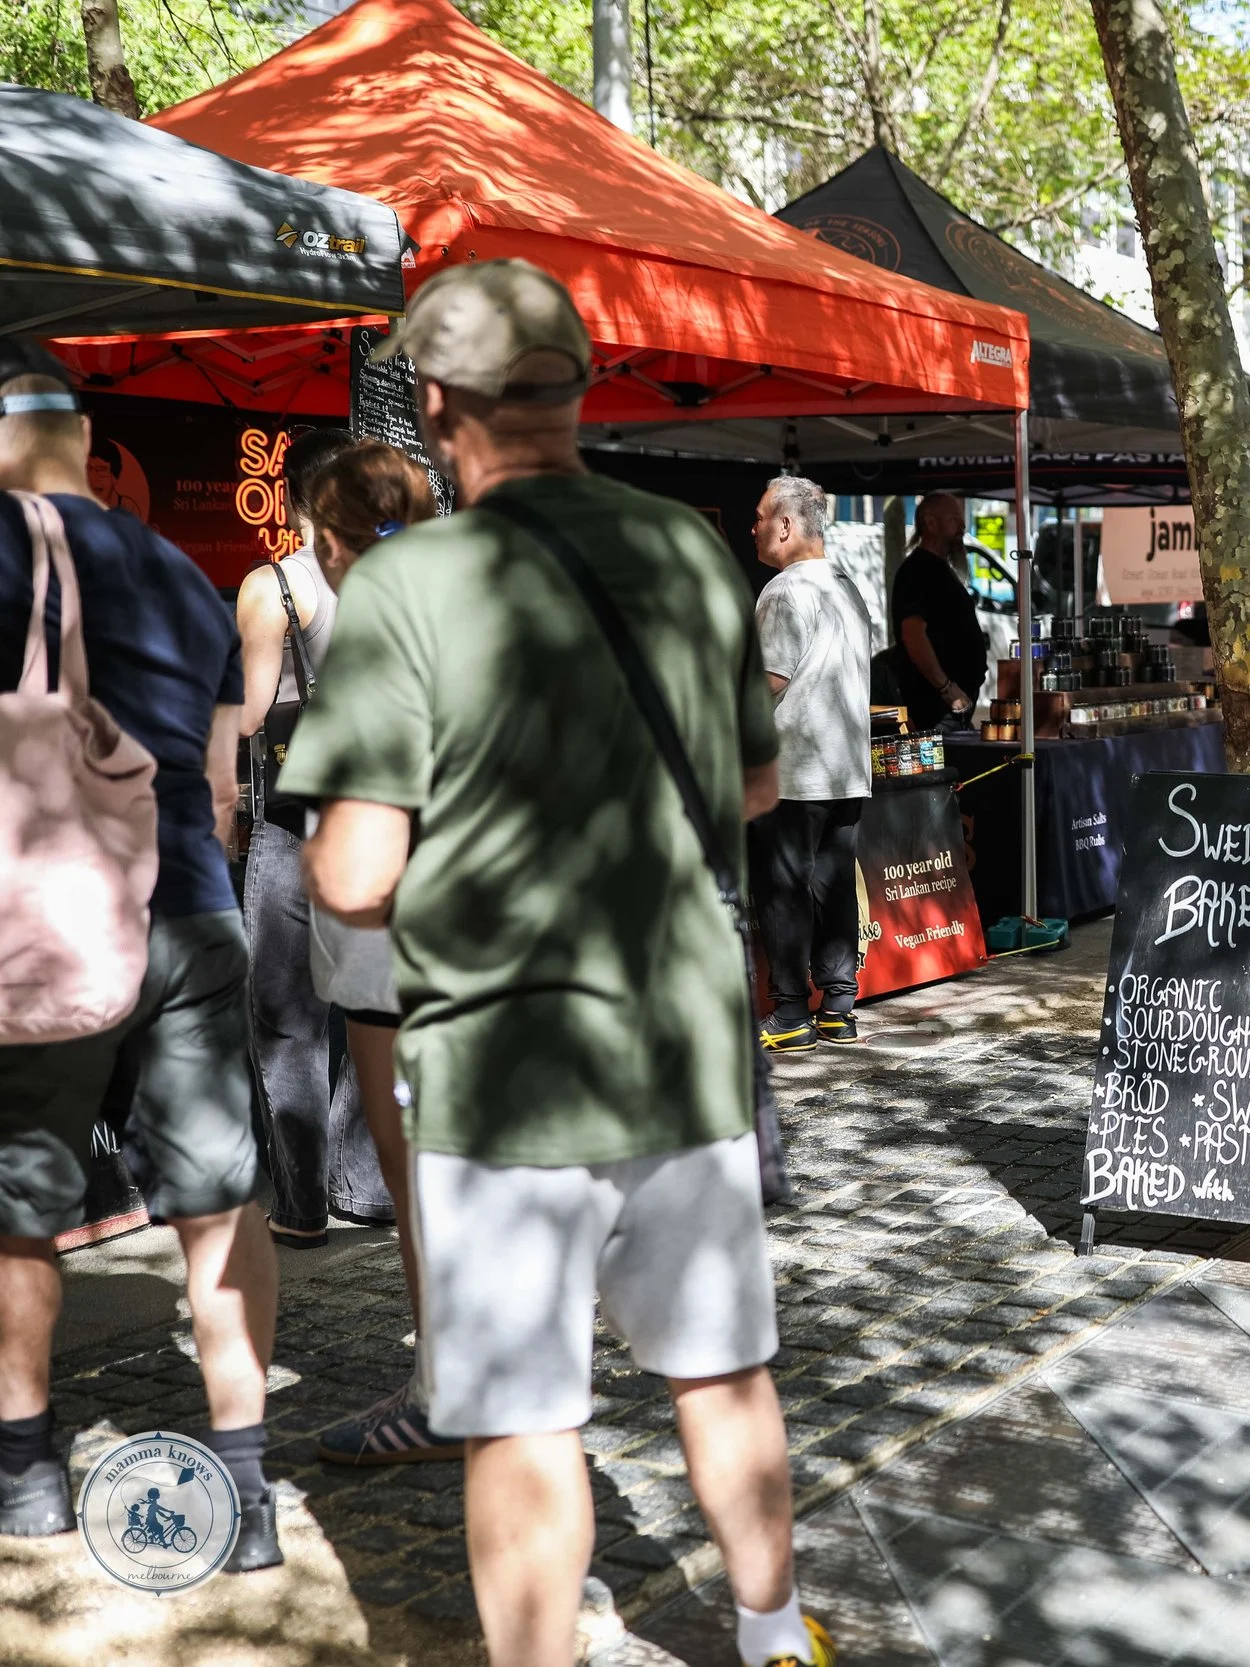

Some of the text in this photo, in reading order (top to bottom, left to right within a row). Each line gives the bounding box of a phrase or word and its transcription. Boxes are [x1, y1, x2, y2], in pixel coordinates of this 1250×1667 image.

[970, 340, 1012, 364] ALTEGRA
[1072, 817, 1092, 830] Artisan
[884, 850, 953, 880] 100 year old
[885, 875, 957, 901] Sri Lankan recipe
[895, 920, 965, 949] Vegan Friendly
[1119, 975, 1222, 1012] ORGANIC
[1101, 1071, 1169, 1115] BRÖD
[1100, 1111, 1169, 1158] PIES
[1081, 1148, 1185, 1211] BAKED
